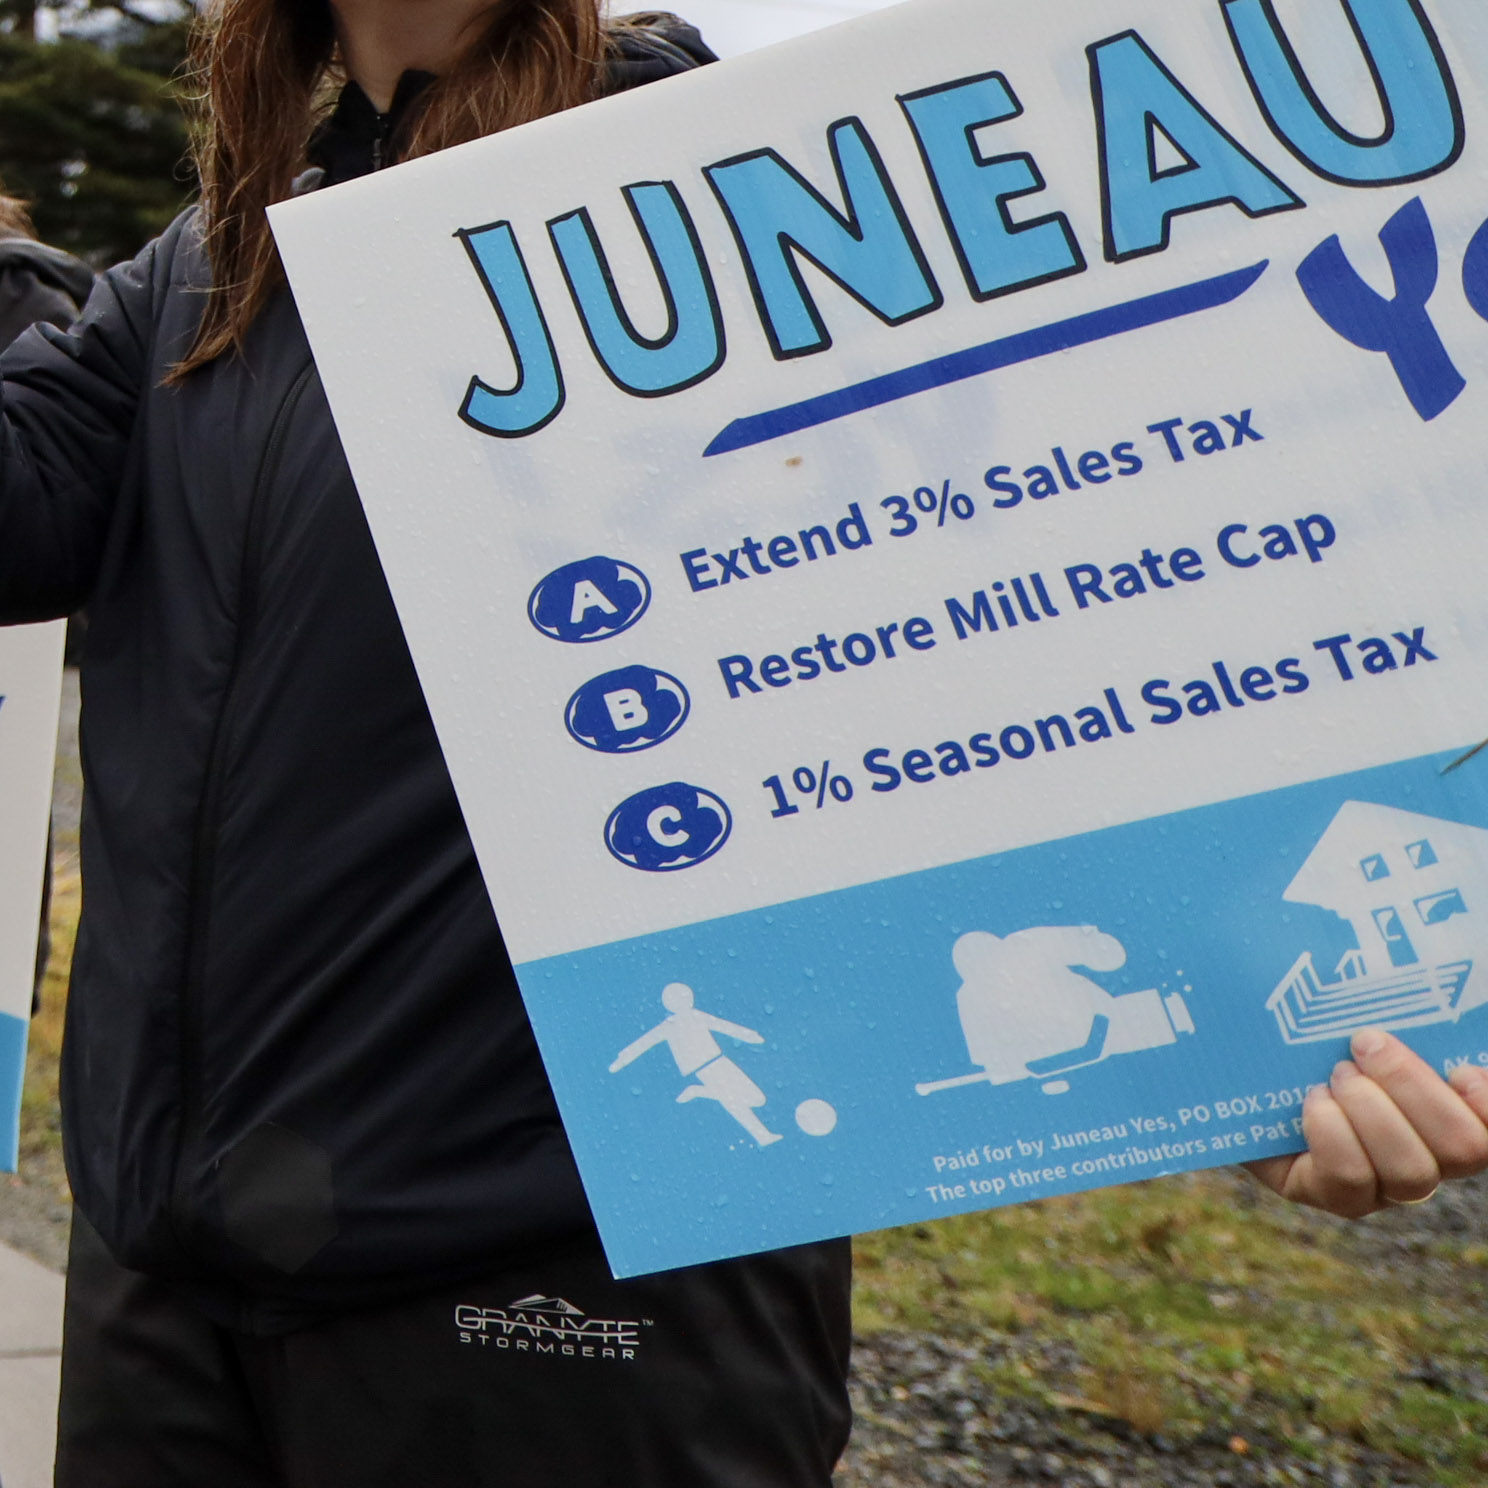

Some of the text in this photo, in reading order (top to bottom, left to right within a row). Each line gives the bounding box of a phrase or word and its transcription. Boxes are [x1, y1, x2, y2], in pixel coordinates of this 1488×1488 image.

[679, 502, 872, 593] Extend
[879, 478, 975, 538] 3%
[983, 446, 1144, 510] Sales
[1146, 407, 1265, 464] Tax
[717, 615, 937, 699] Restore
[944, 572, 1060, 640] Mill
[1062, 545, 1206, 610] Rate
[1216, 512, 1337, 563] Cap
[761, 759, 854, 819] 1%
[861, 687, 1135, 792] Seasonal
[1140, 655, 1310, 725] Sales
[1312, 625, 1439, 681] Tax
[925, 1184, 967, 1204] The
[969, 1174, 1007, 1197] top
[1008, 1164, 1067, 1189] three
[1070, 1134, 1208, 1175] contributors
[1210, 1130, 1247, 1152] are
[1250, 1121, 1290, 1142] Pat
[932, 1151, 980, 1173] Paid
[982, 1144, 1013, 1164] for
[1016, 1137, 1044, 1161] by
[1050, 1122, 1128, 1151] Juneau
[1128, 1115, 1177, 1135] Yes,
[1178, 1104, 1211, 1127] PO
[1214, 1096, 1263, 1120] BOX
[455, 1304, 640, 1345] GRANYTE
[459, 1332, 635, 1360] STORMGEAR
